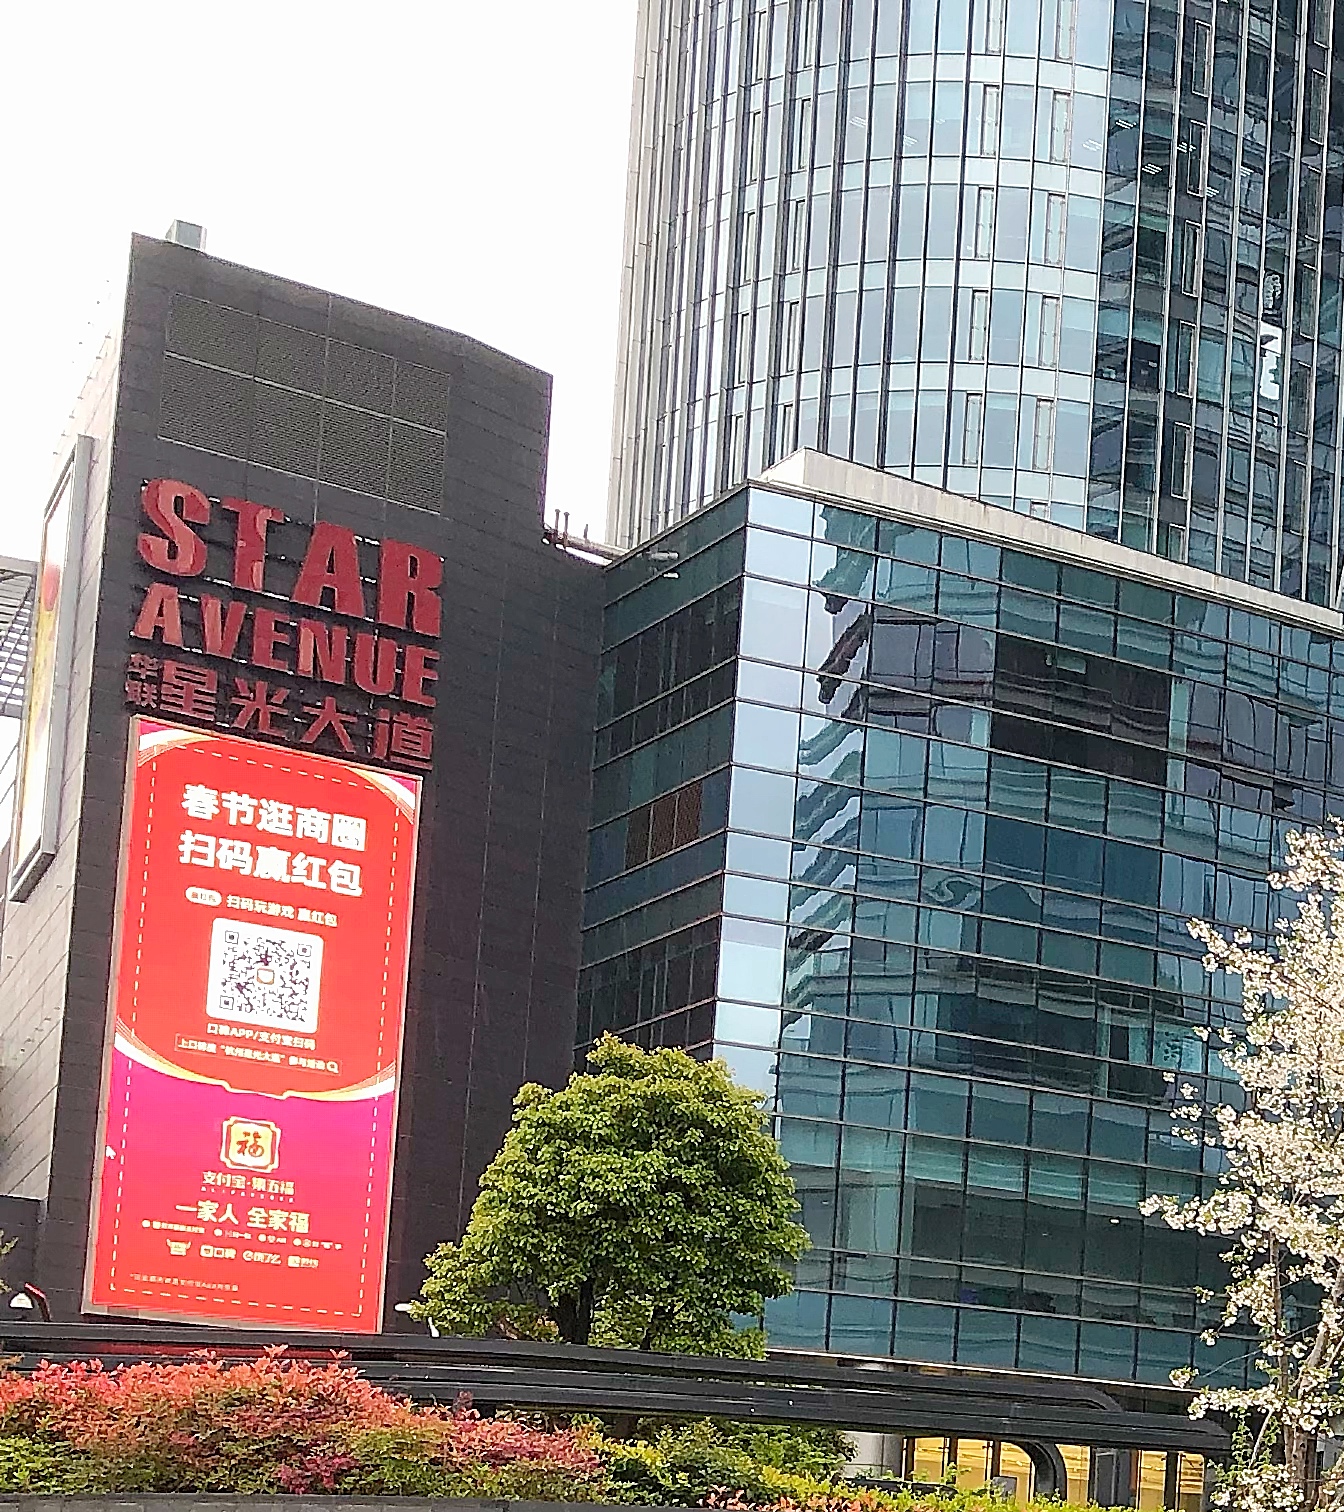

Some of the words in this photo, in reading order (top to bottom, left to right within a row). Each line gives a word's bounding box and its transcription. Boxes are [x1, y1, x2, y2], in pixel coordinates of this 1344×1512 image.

[137, 478, 444, 637] STAR
[132, 582, 440, 707] AVENUE
[160, 660, 434, 772] 星光大道
[181, 784, 367, 852] 春节逛商圈
[178, 829, 363, 897] 扫码赢红包
[226, 894, 295, 919] 扫码玩游戏
[175, 1200, 239, 1225] 一家人
[246, 1207, 310, 1234] 全家福
